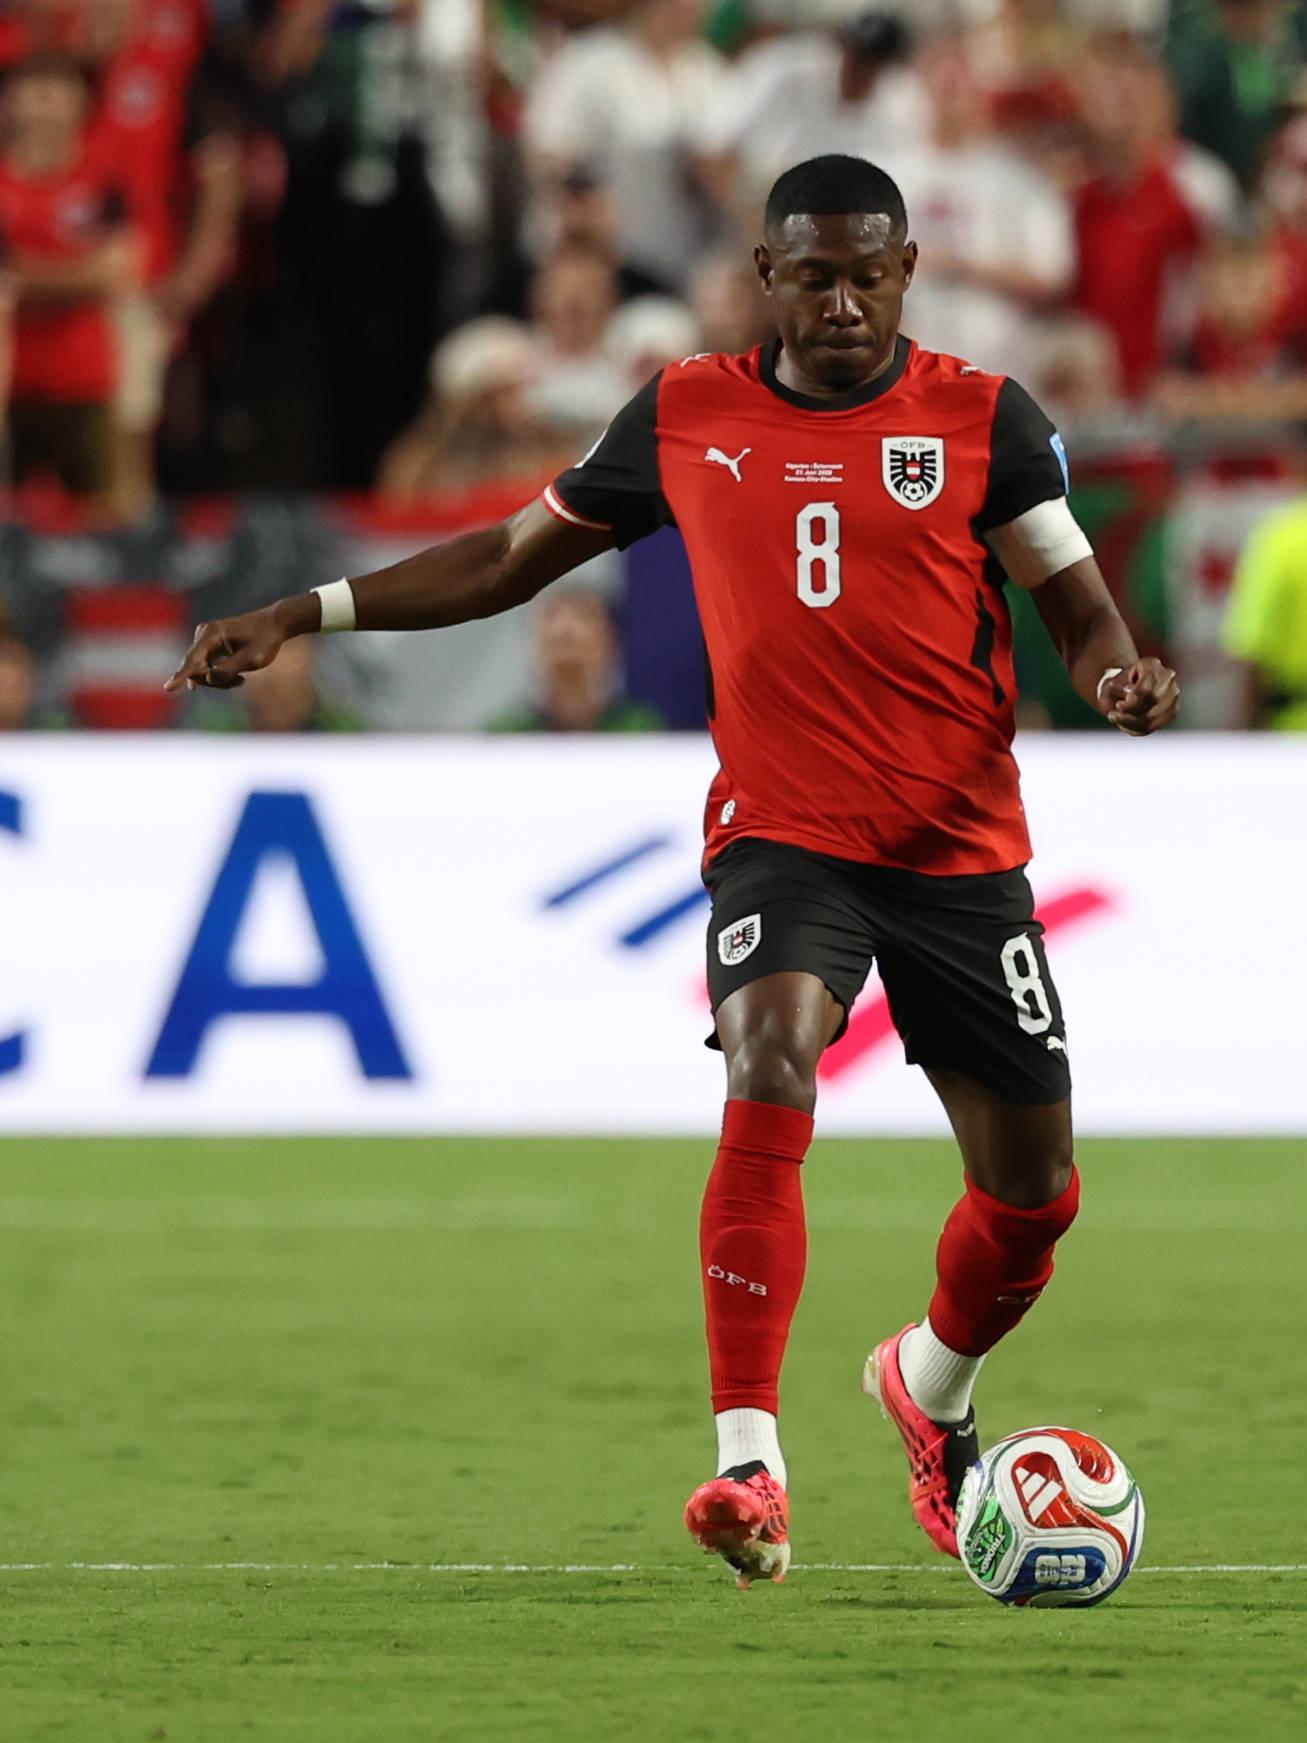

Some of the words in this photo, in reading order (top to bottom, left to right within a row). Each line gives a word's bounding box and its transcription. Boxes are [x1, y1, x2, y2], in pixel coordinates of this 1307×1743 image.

[796, 502, 841, 608] 8
[1000, 931, 1052, 1035] 8
[707, 1264, 767, 1297] ÖFB
